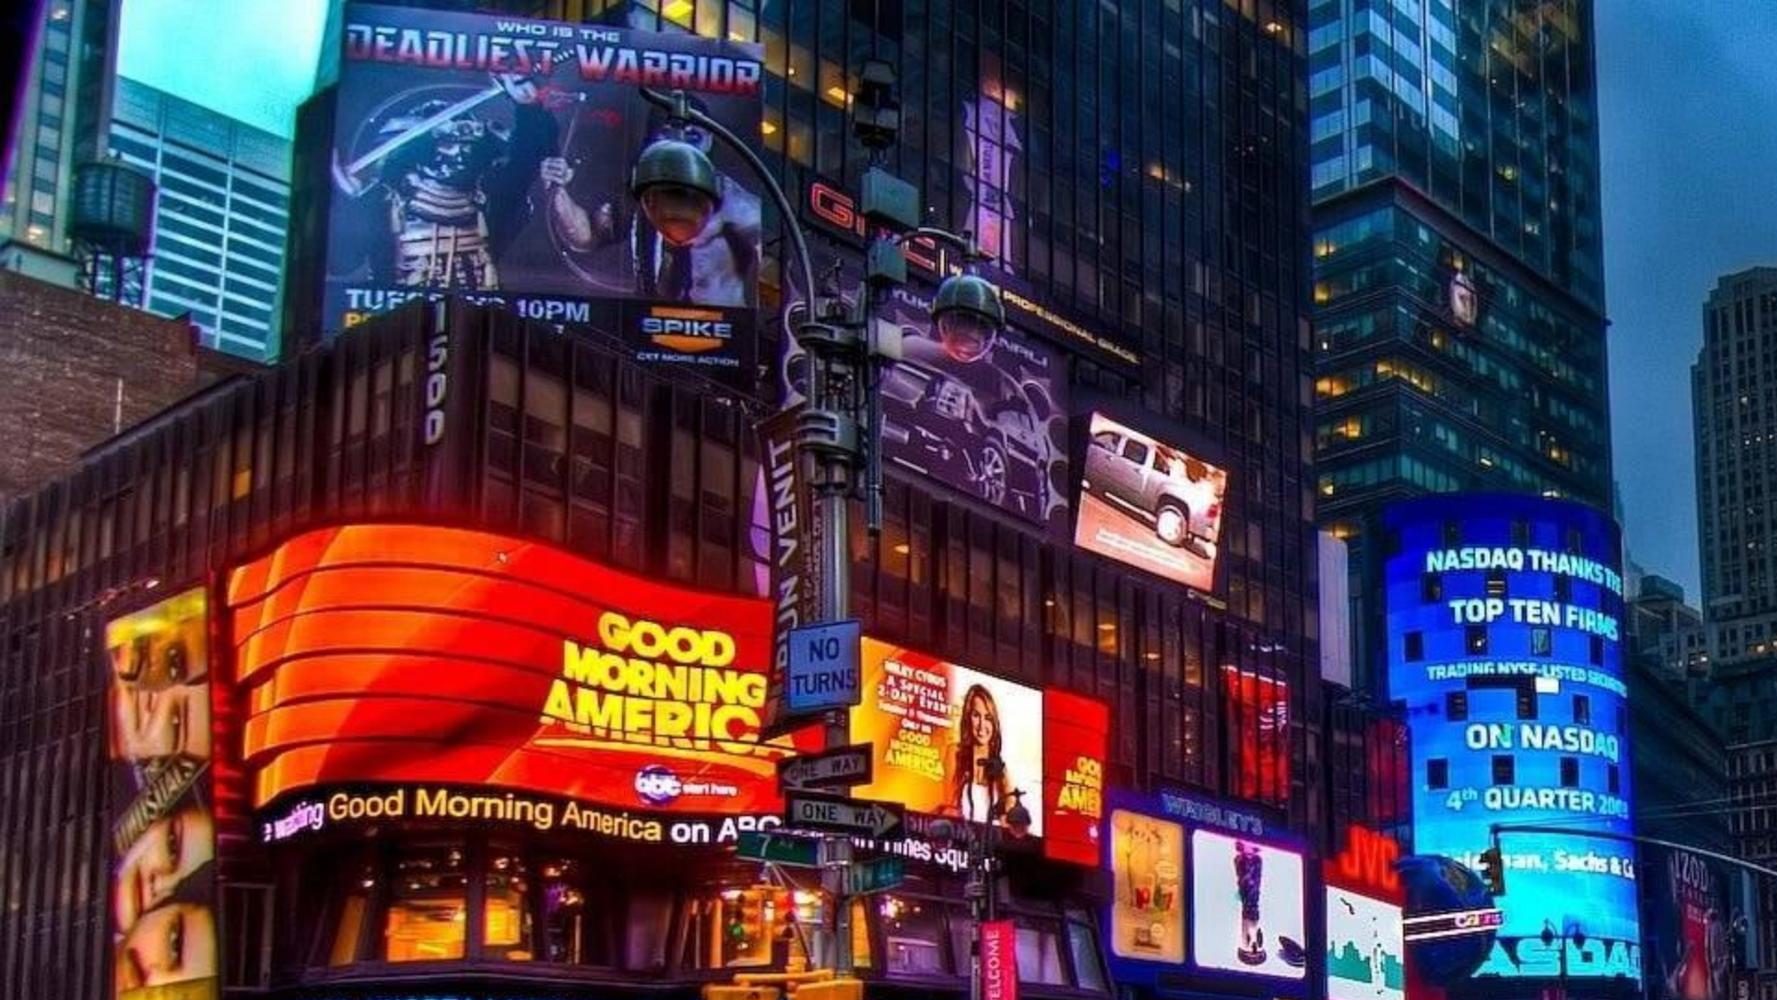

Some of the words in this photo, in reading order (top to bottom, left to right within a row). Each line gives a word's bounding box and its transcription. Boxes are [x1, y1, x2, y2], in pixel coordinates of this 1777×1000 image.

[497, 21, 547, 38] WHO
[553, 26, 574, 40] IS
[580, 28, 621, 42] THE
[347, 24, 560, 74] DEADLIEST
[576, 43, 761, 94] WARRIOR
[516, 299, 590, 323] 10PM
[643, 318, 732, 338] SPIKE
[425, 301, 448, 445] 1500
[769, 439, 798, 567] VENIT
[1426, 548, 1524, 573] NASDAQ
[1527, 550, 1604, 584] THANKS
[1449, 598, 1504, 624] TOP
[1509, 598, 1561, 626] TEN
[1566, 604, 1618, 641] FIRMS
[598, 611, 737, 669] GOOD
[809, 636, 841, 664] NO
[563, 641, 768, 707] MORNING
[791, 668, 858, 697] TURNS
[1426, 662, 1494, 681] TRADING
[1467, 725, 1513, 750] ON
[1521, 725, 1620, 763] NASDAQ
[831, 756, 861, 775] WAY
[328, 789, 405, 822] Good
[415, 788, 554, 831] Morning
[560, 801, 663, 842] America
[671, 819, 709, 844] on
[803, 803, 838, 820] ONE
[853, 807, 887, 827] WAY
[1446, 788, 1478, 811] 4th
[1484, 788, 1596, 813] QUARTER
[757, 832, 771, 858] 7
[1342, 823, 1399, 888] JVC
[1471, 937, 1642, 985] ASDA
